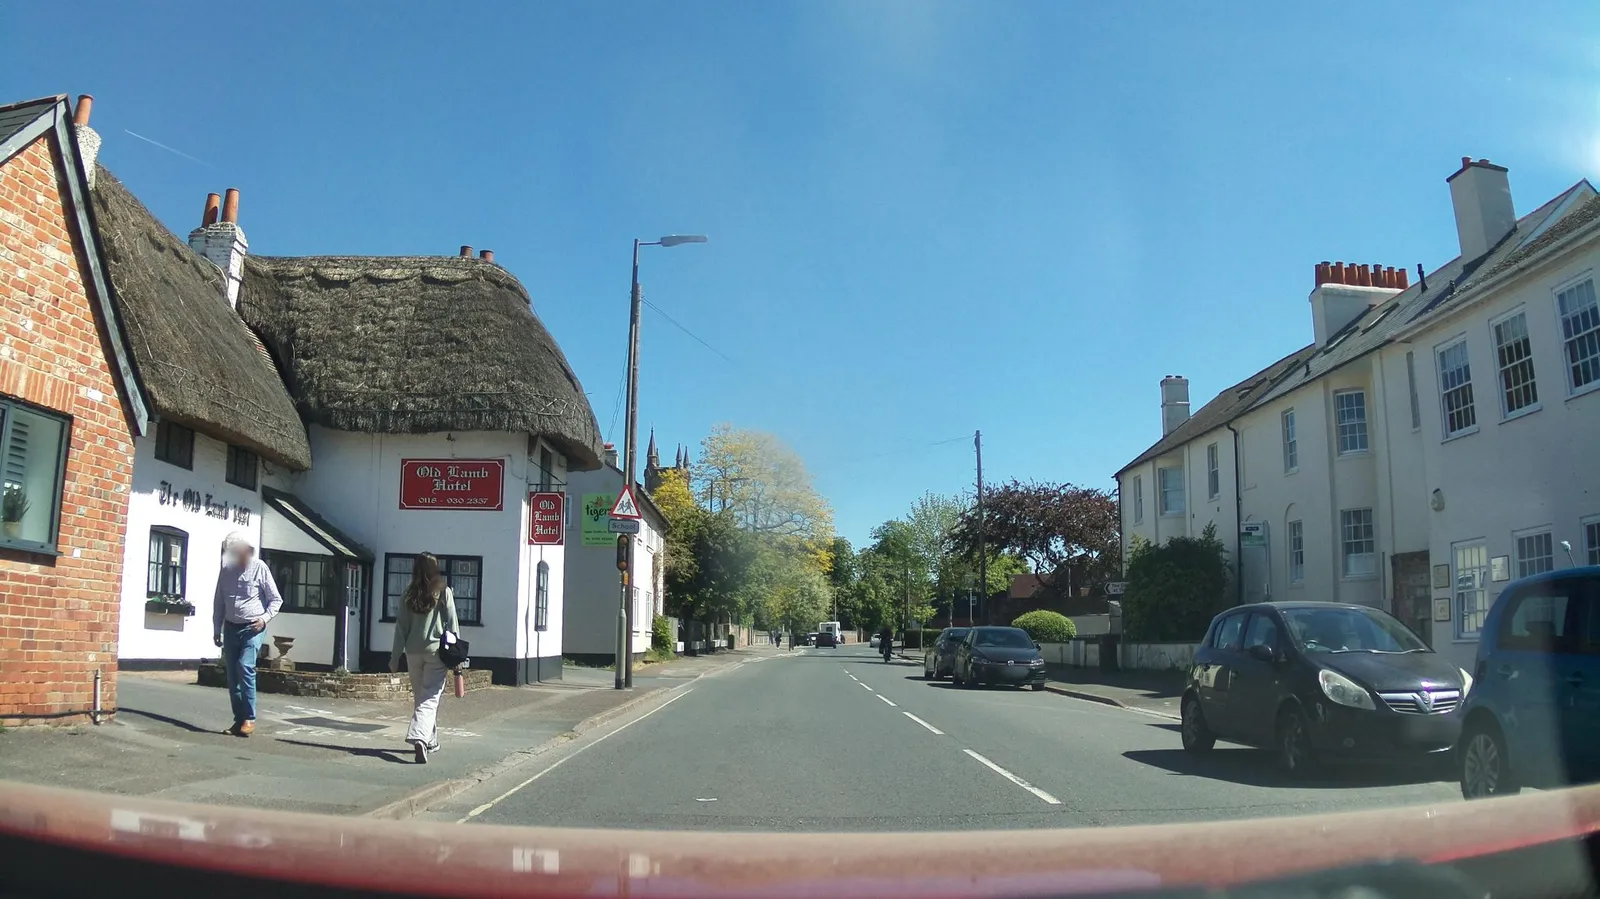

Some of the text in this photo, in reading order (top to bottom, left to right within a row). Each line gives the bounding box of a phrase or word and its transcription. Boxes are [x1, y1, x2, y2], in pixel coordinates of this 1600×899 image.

[416, 465, 489, 482] Old Lamb
[432, 478, 472, 494] Hotel
[183, 488, 201, 513] Old
[539, 499, 555, 510] Old
[534, 511, 560, 525] Lamb
[585, 504, 611, 522] tiger
[534, 525, 559, 538] Hotel
